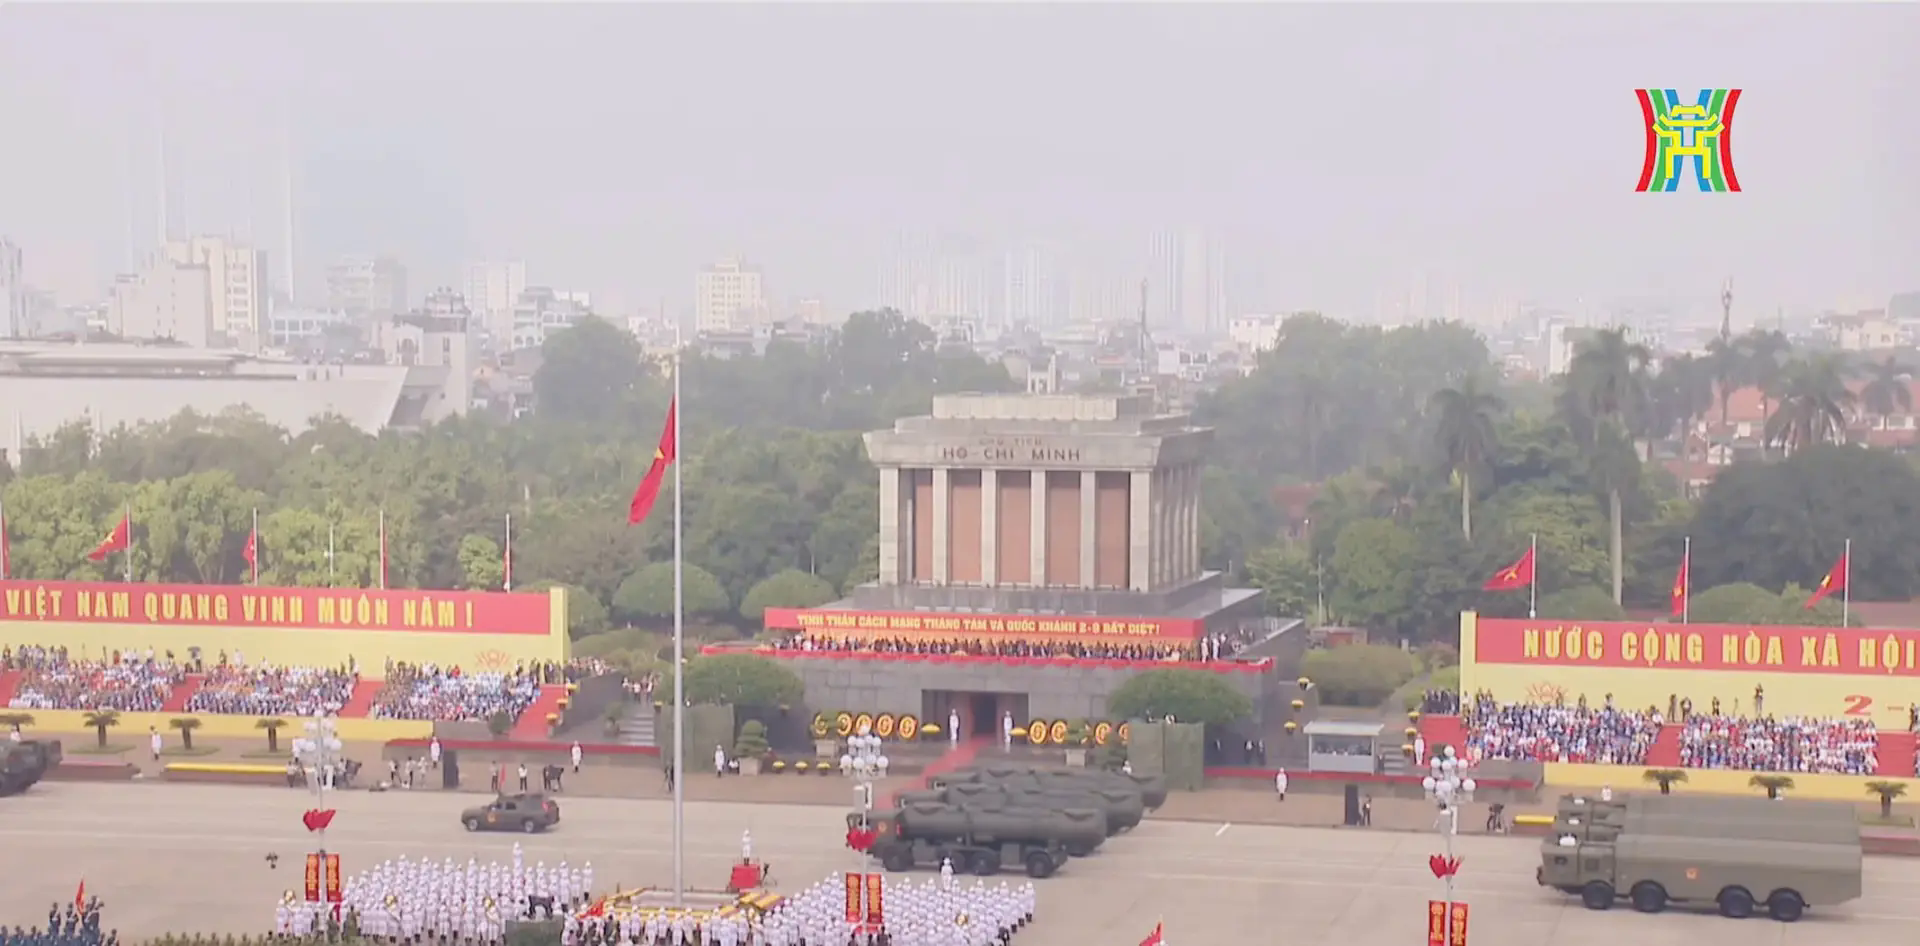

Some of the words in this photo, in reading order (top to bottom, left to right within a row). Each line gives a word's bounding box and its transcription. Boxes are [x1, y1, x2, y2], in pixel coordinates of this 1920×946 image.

[1031, 449, 1080, 461] MINH
[6, 585, 63, 621] VIỆT
[77, 590, 130, 618] NAM
[144, 592, 229, 622] QUANG
[242, 595, 303, 623] VINH
[318, 592, 388, 625] MUÔN
[403, 595, 455, 627] NĂM
[1523, 625, 1604, 660] NƯỚC
[1621, 628, 1703, 667] CỘNG
[1722, 630, 1783, 665] HÒA
[1801, 633, 1839, 666] XÃ
[1859, 633, 1915, 674] HỘI
